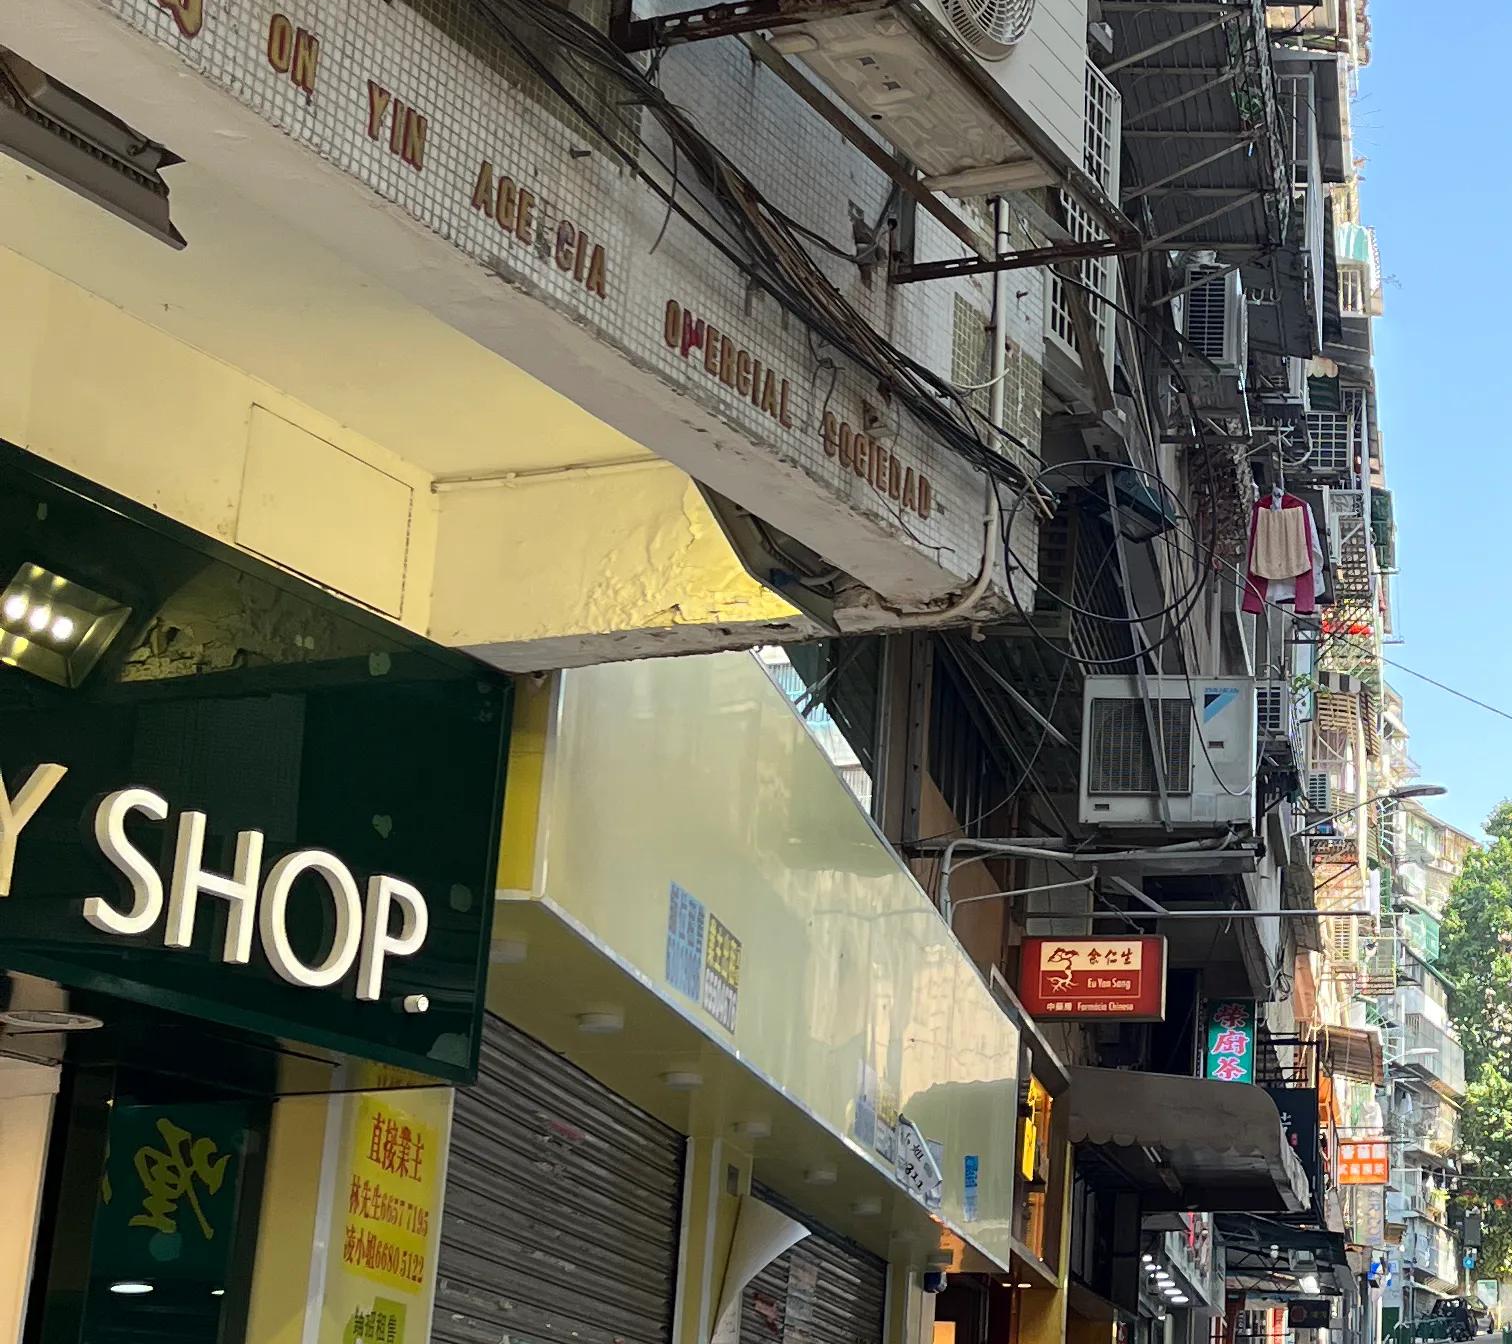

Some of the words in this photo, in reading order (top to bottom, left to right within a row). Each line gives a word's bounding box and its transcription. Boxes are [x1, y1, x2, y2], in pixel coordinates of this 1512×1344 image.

[367, 79, 428, 172] YIN
[1087, 978, 1097, 989] Eu
[1112, 978, 1131, 990] Sang
